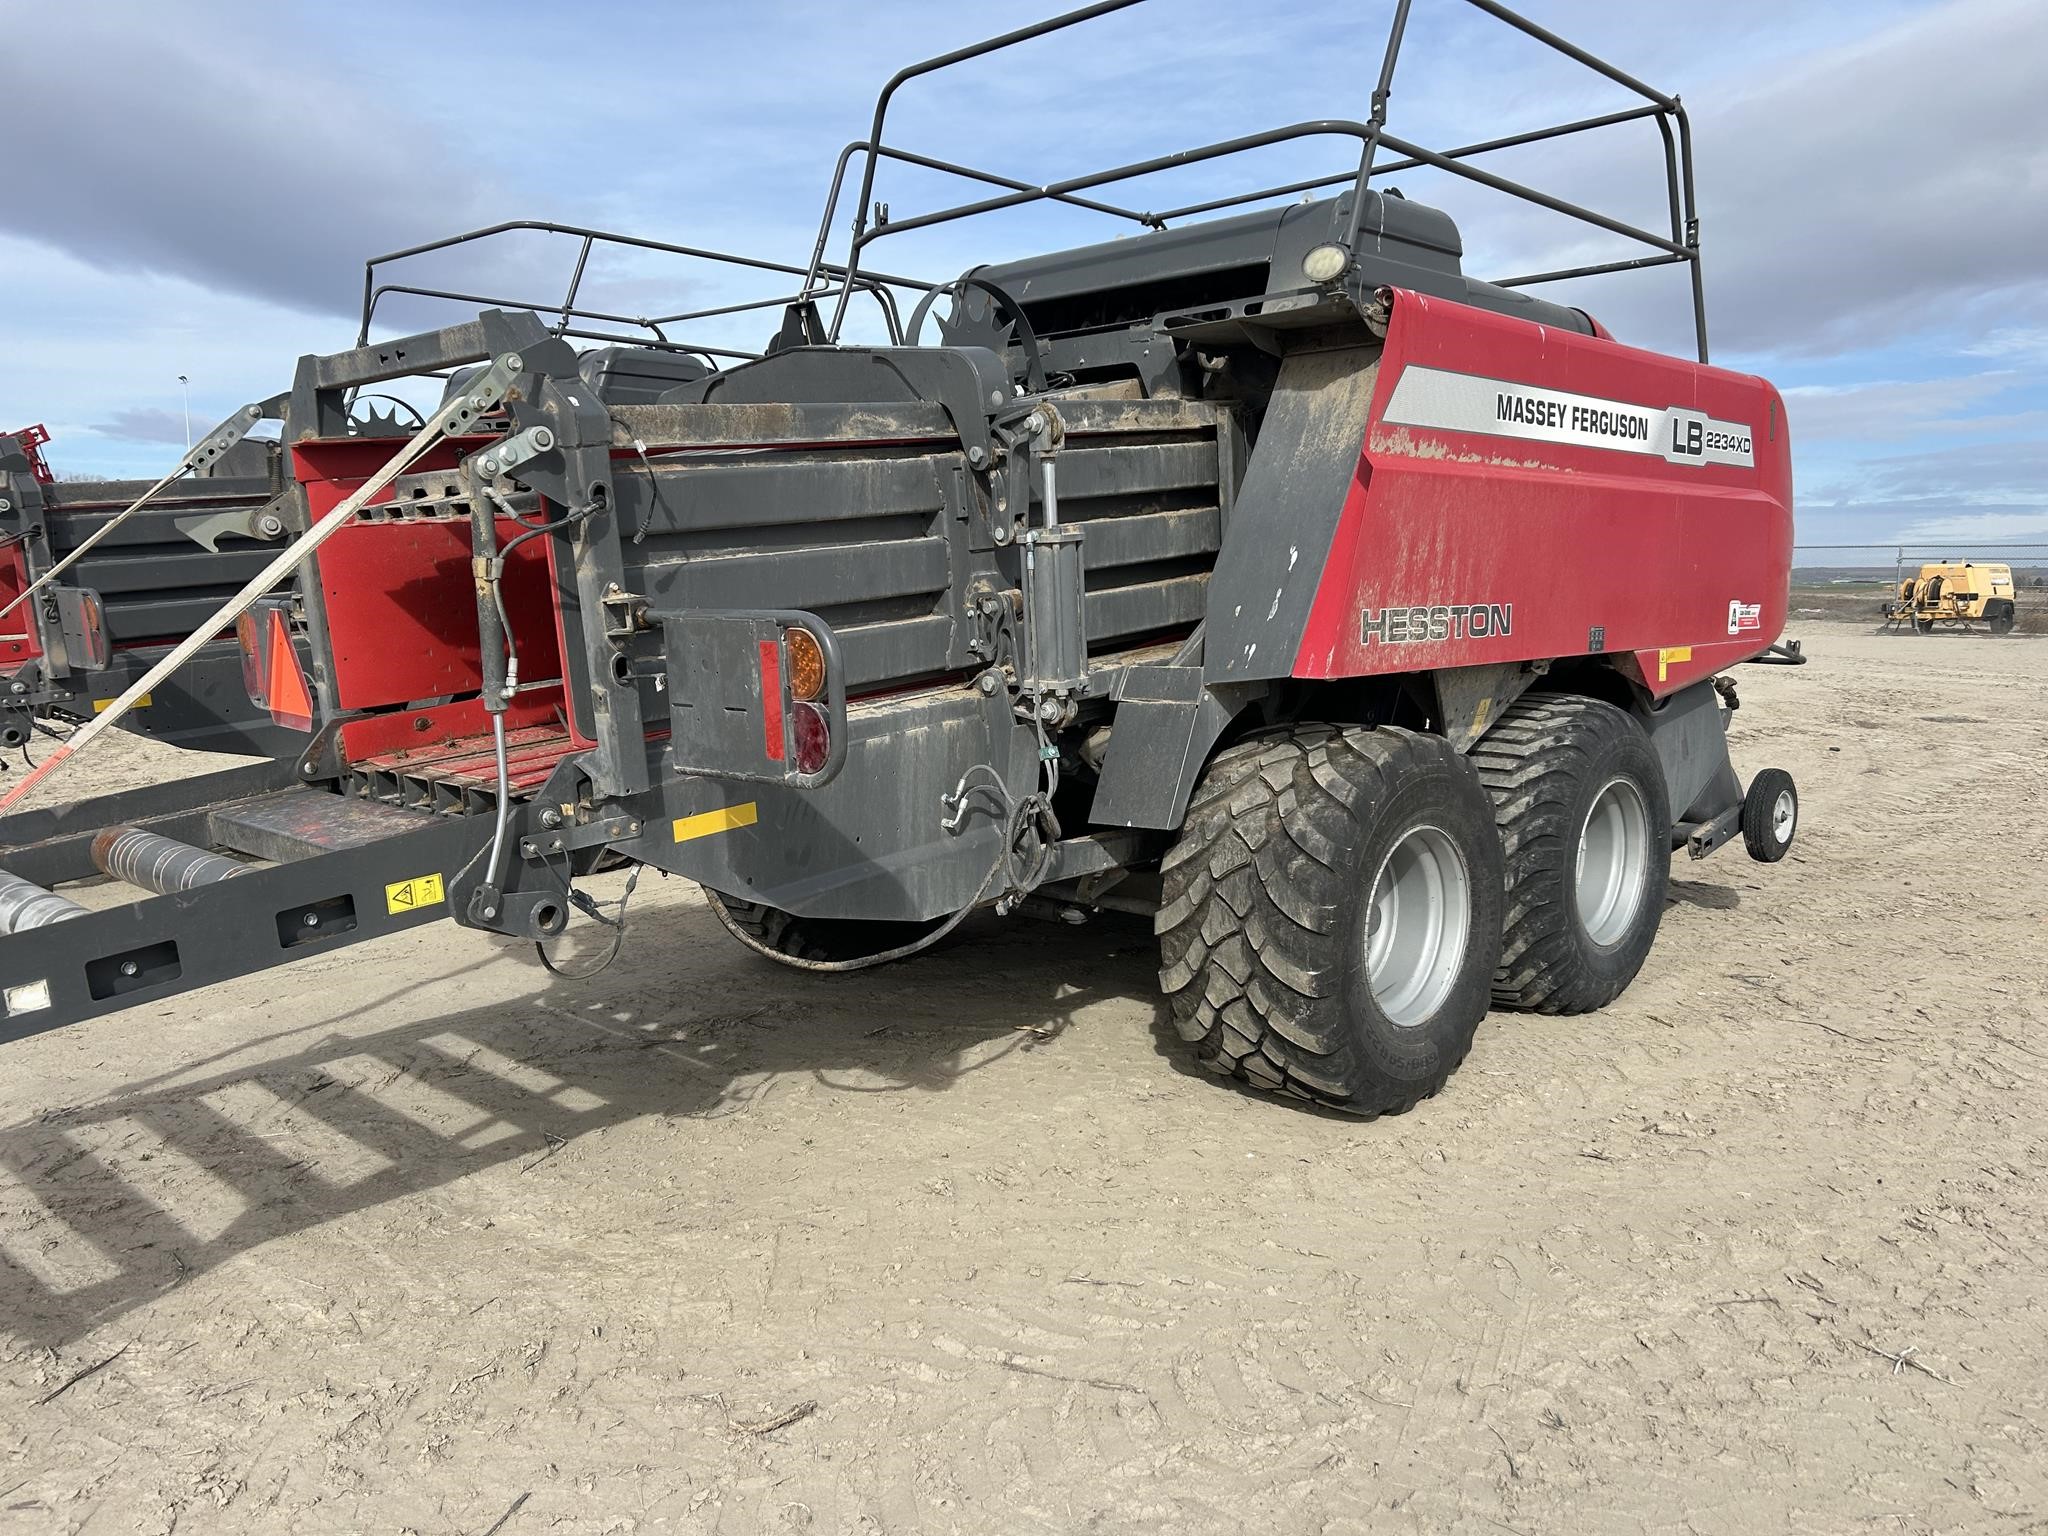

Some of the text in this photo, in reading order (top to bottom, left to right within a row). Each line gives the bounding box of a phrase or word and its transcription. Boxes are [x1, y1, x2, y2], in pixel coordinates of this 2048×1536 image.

[1496, 393, 1649, 441] MASSEY FERGUSON
[1672, 417, 1751, 456] LB 2234XD
[1361, 603, 1512, 645] HESSTON
